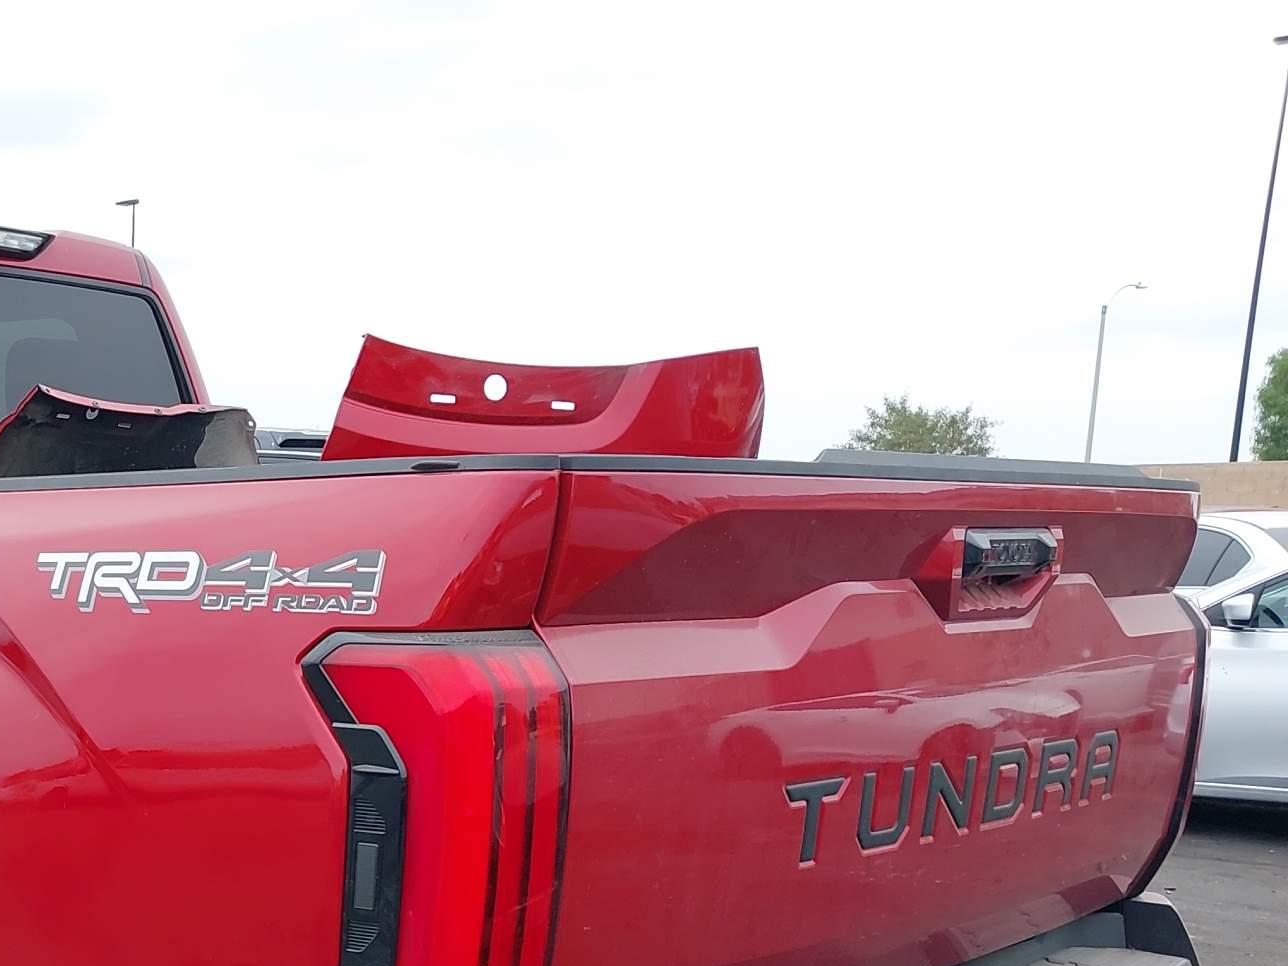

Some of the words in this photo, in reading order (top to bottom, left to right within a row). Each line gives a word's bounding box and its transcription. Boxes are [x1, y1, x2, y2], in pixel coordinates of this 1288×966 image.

[37, 551, 205, 614] TRD
[202, 549, 385, 597] 4x4
[199, 593, 267, 611] OFF
[272, 593, 378, 615] ROAD
[783, 729, 1120, 868] TUNDRA
